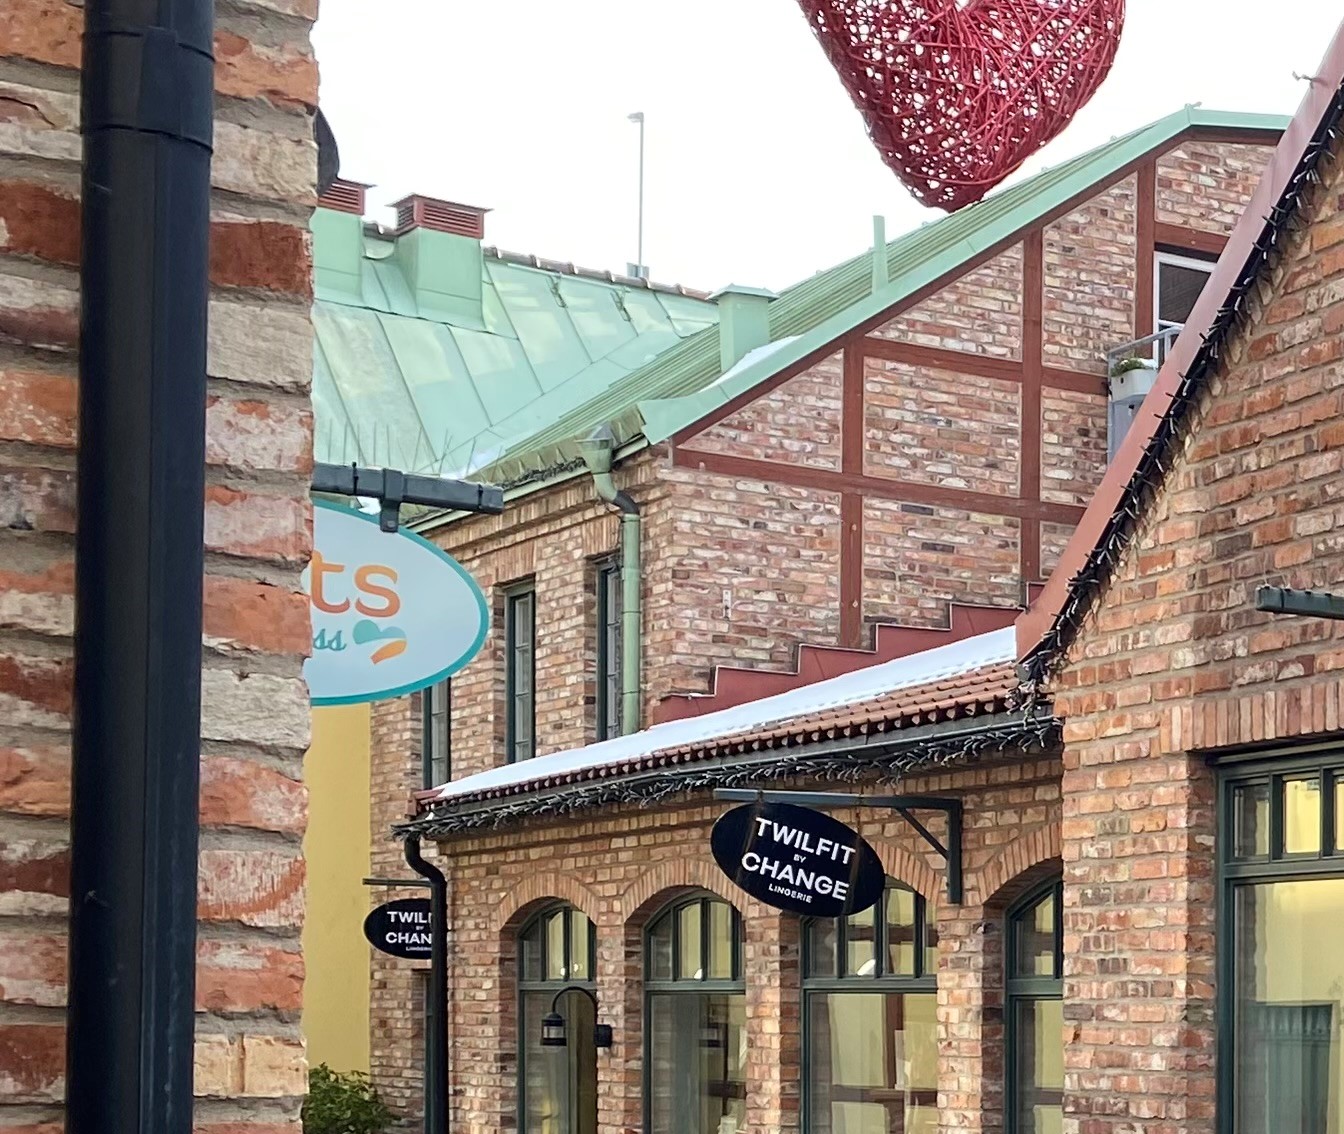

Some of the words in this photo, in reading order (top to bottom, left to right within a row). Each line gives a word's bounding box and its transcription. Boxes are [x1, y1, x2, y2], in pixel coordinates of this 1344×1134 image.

[756, 817, 856, 864] TWILFIT
[793, 854, 806, 863] BY
[741, 852, 849, 901] CHANGE
[768, 883, 813, 903] LINGERIE
[385, 932, 432, 944] CHAN
